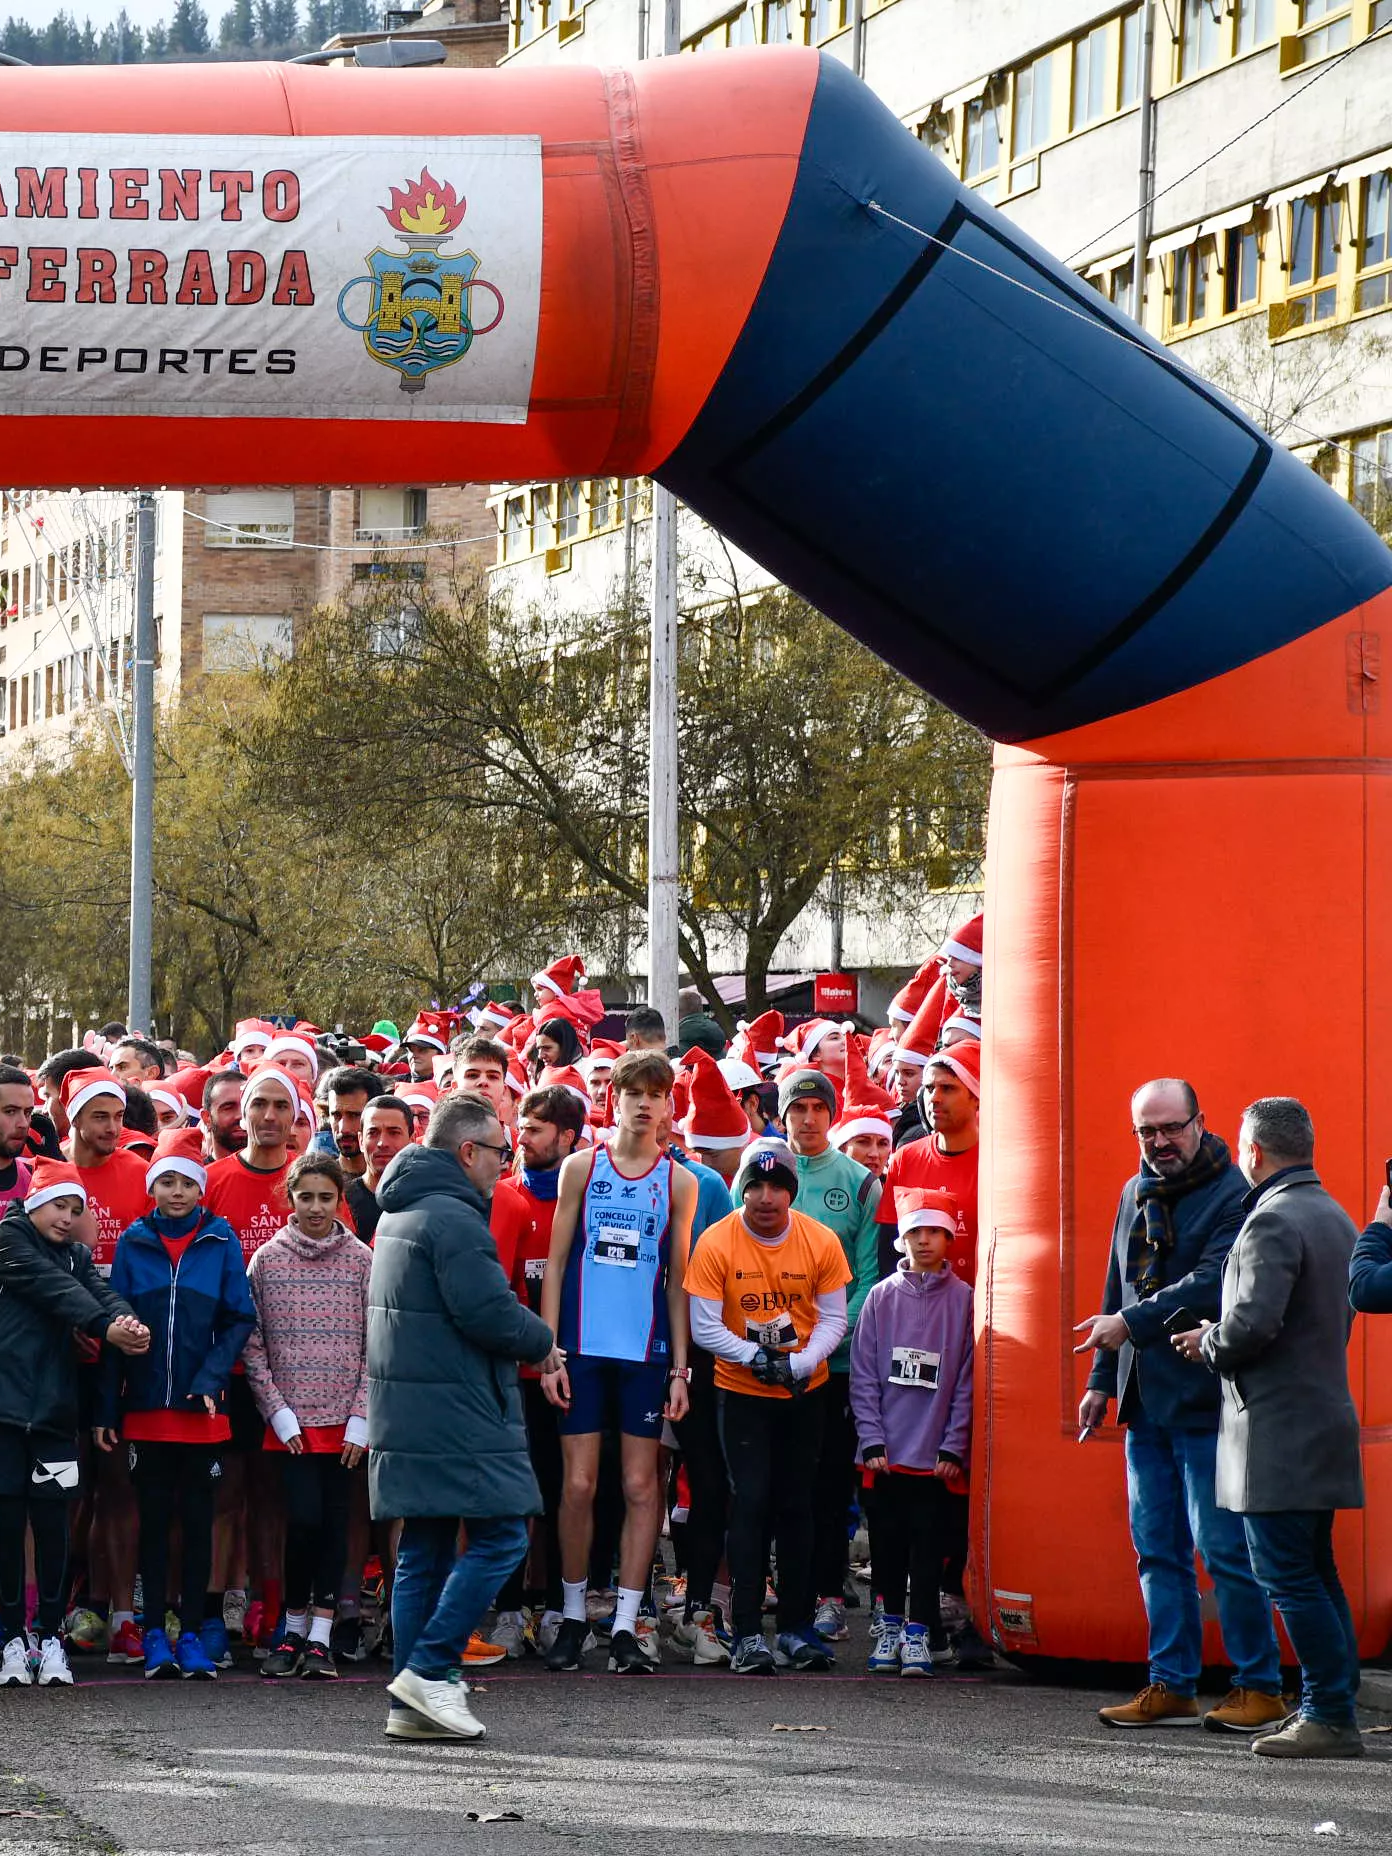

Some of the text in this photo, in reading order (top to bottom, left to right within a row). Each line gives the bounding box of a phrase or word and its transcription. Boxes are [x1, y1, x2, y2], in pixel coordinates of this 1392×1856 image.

[250, 1215, 281, 1228] SAN
[594, 1211, 636, 1222] CONCELLO
[611, 1222, 632, 1230] VIGO
[240, 1227, 279, 1239] SILVES
[759, 1329, 781, 1344] 68
